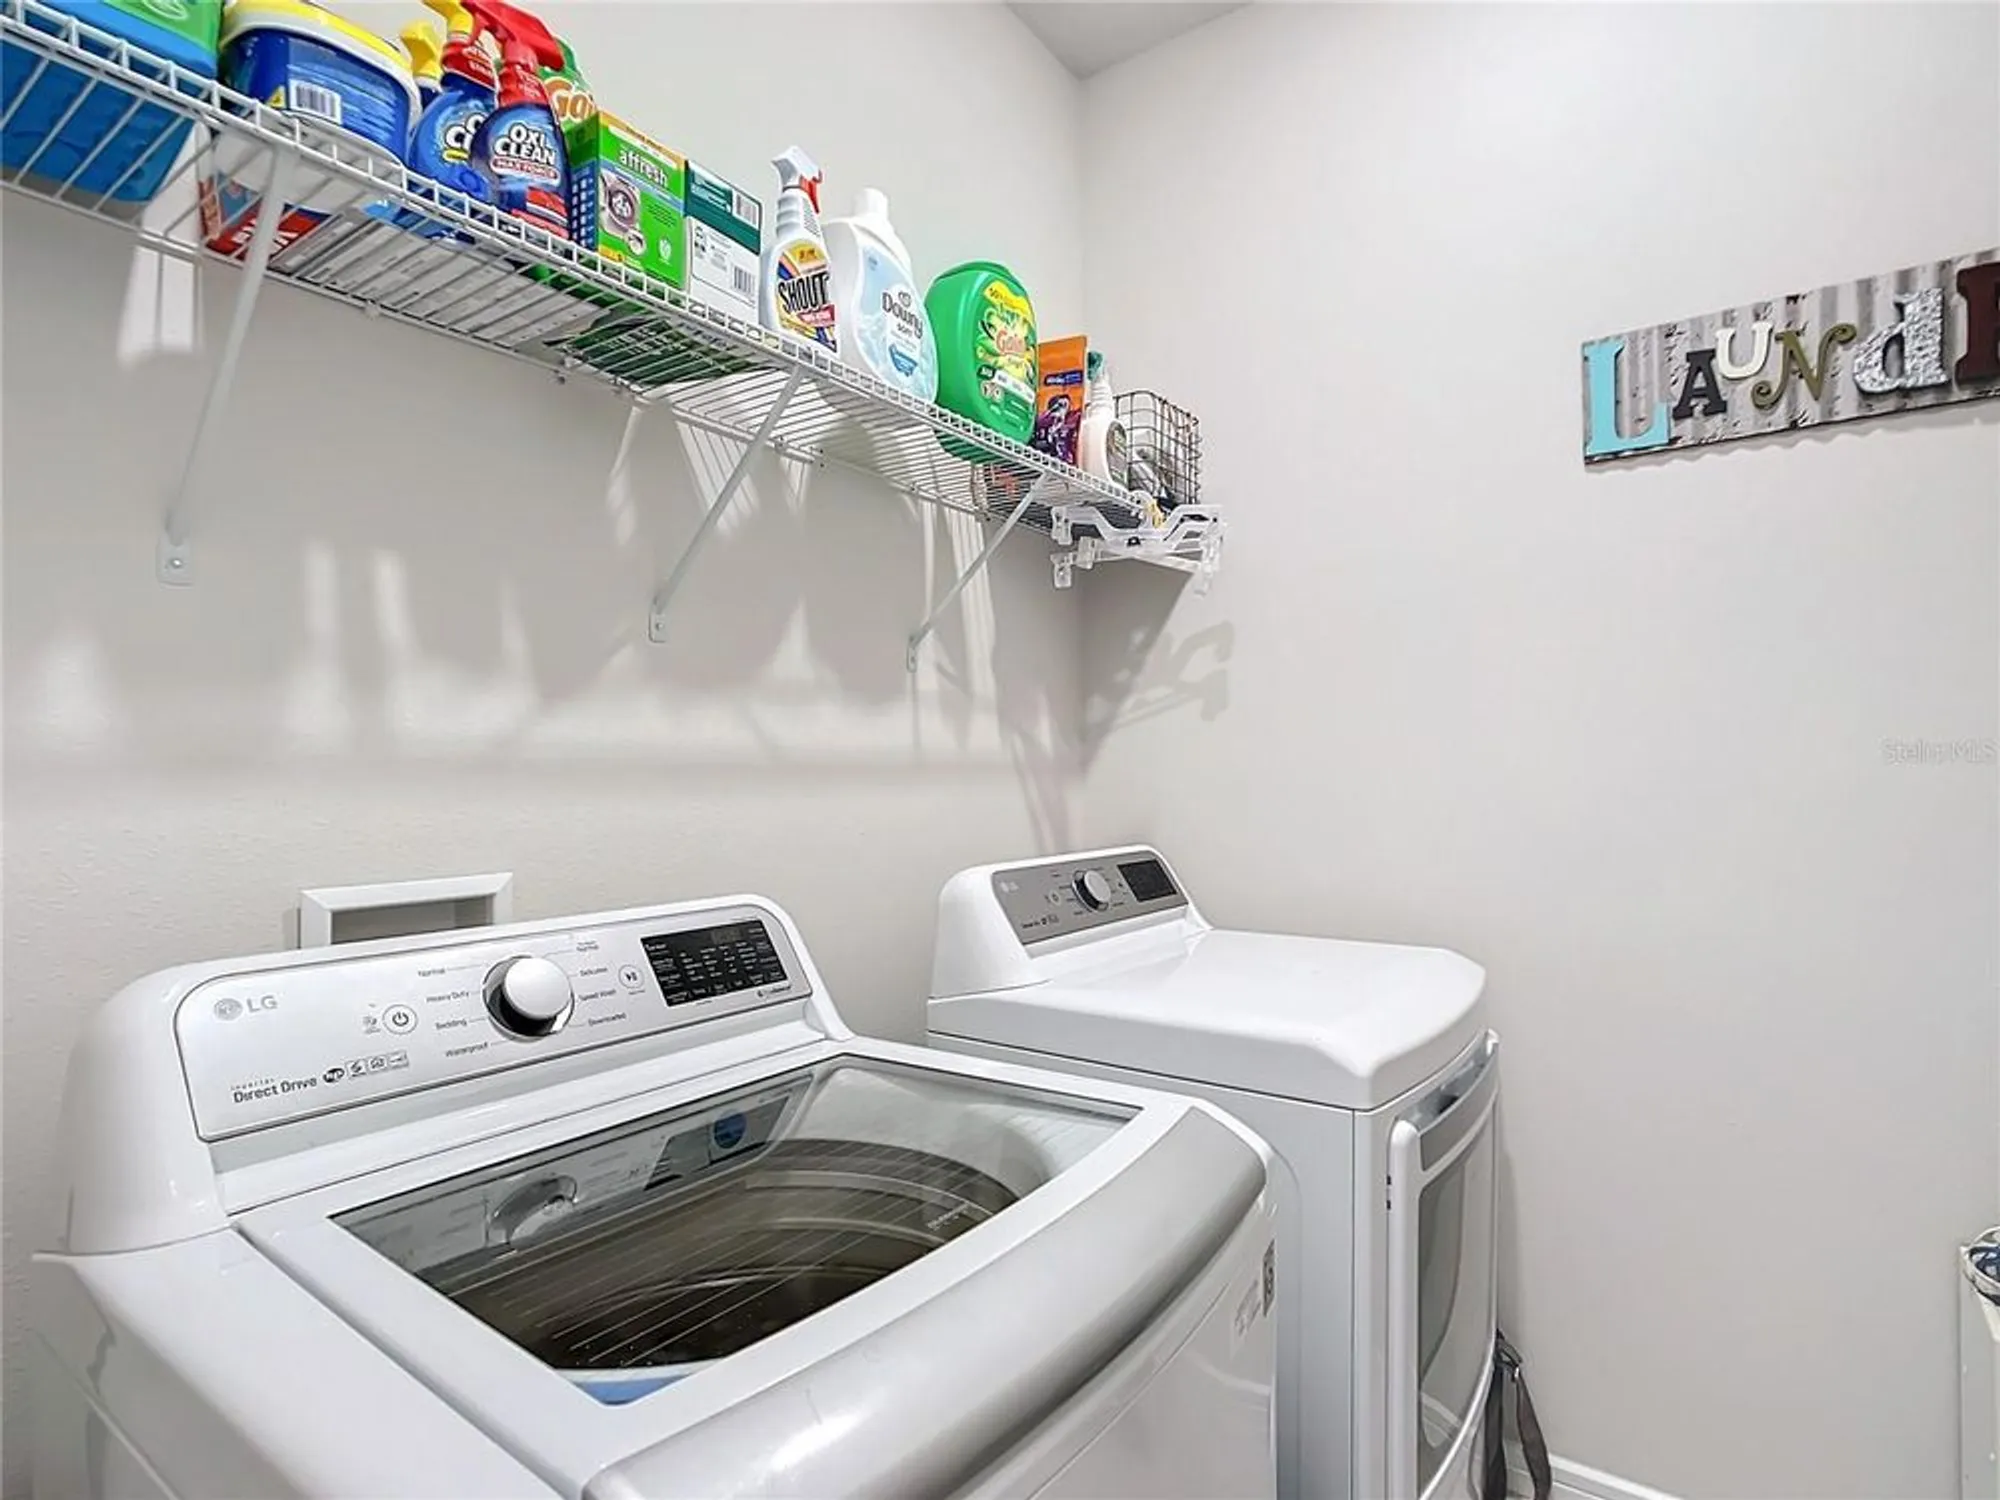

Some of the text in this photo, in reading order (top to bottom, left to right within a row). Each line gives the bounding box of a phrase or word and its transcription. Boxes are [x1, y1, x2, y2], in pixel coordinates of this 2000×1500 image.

[494, 137, 556, 166] CLEAN
[619, 149, 668, 190] affresh
[778, 271, 830, 315] SHOUT
[881, 291, 924, 340] Downy
[246, 994, 279, 1014] LG
[233, 1084, 279, 1104] Direct
[281, 1076, 318, 1095] Drive
